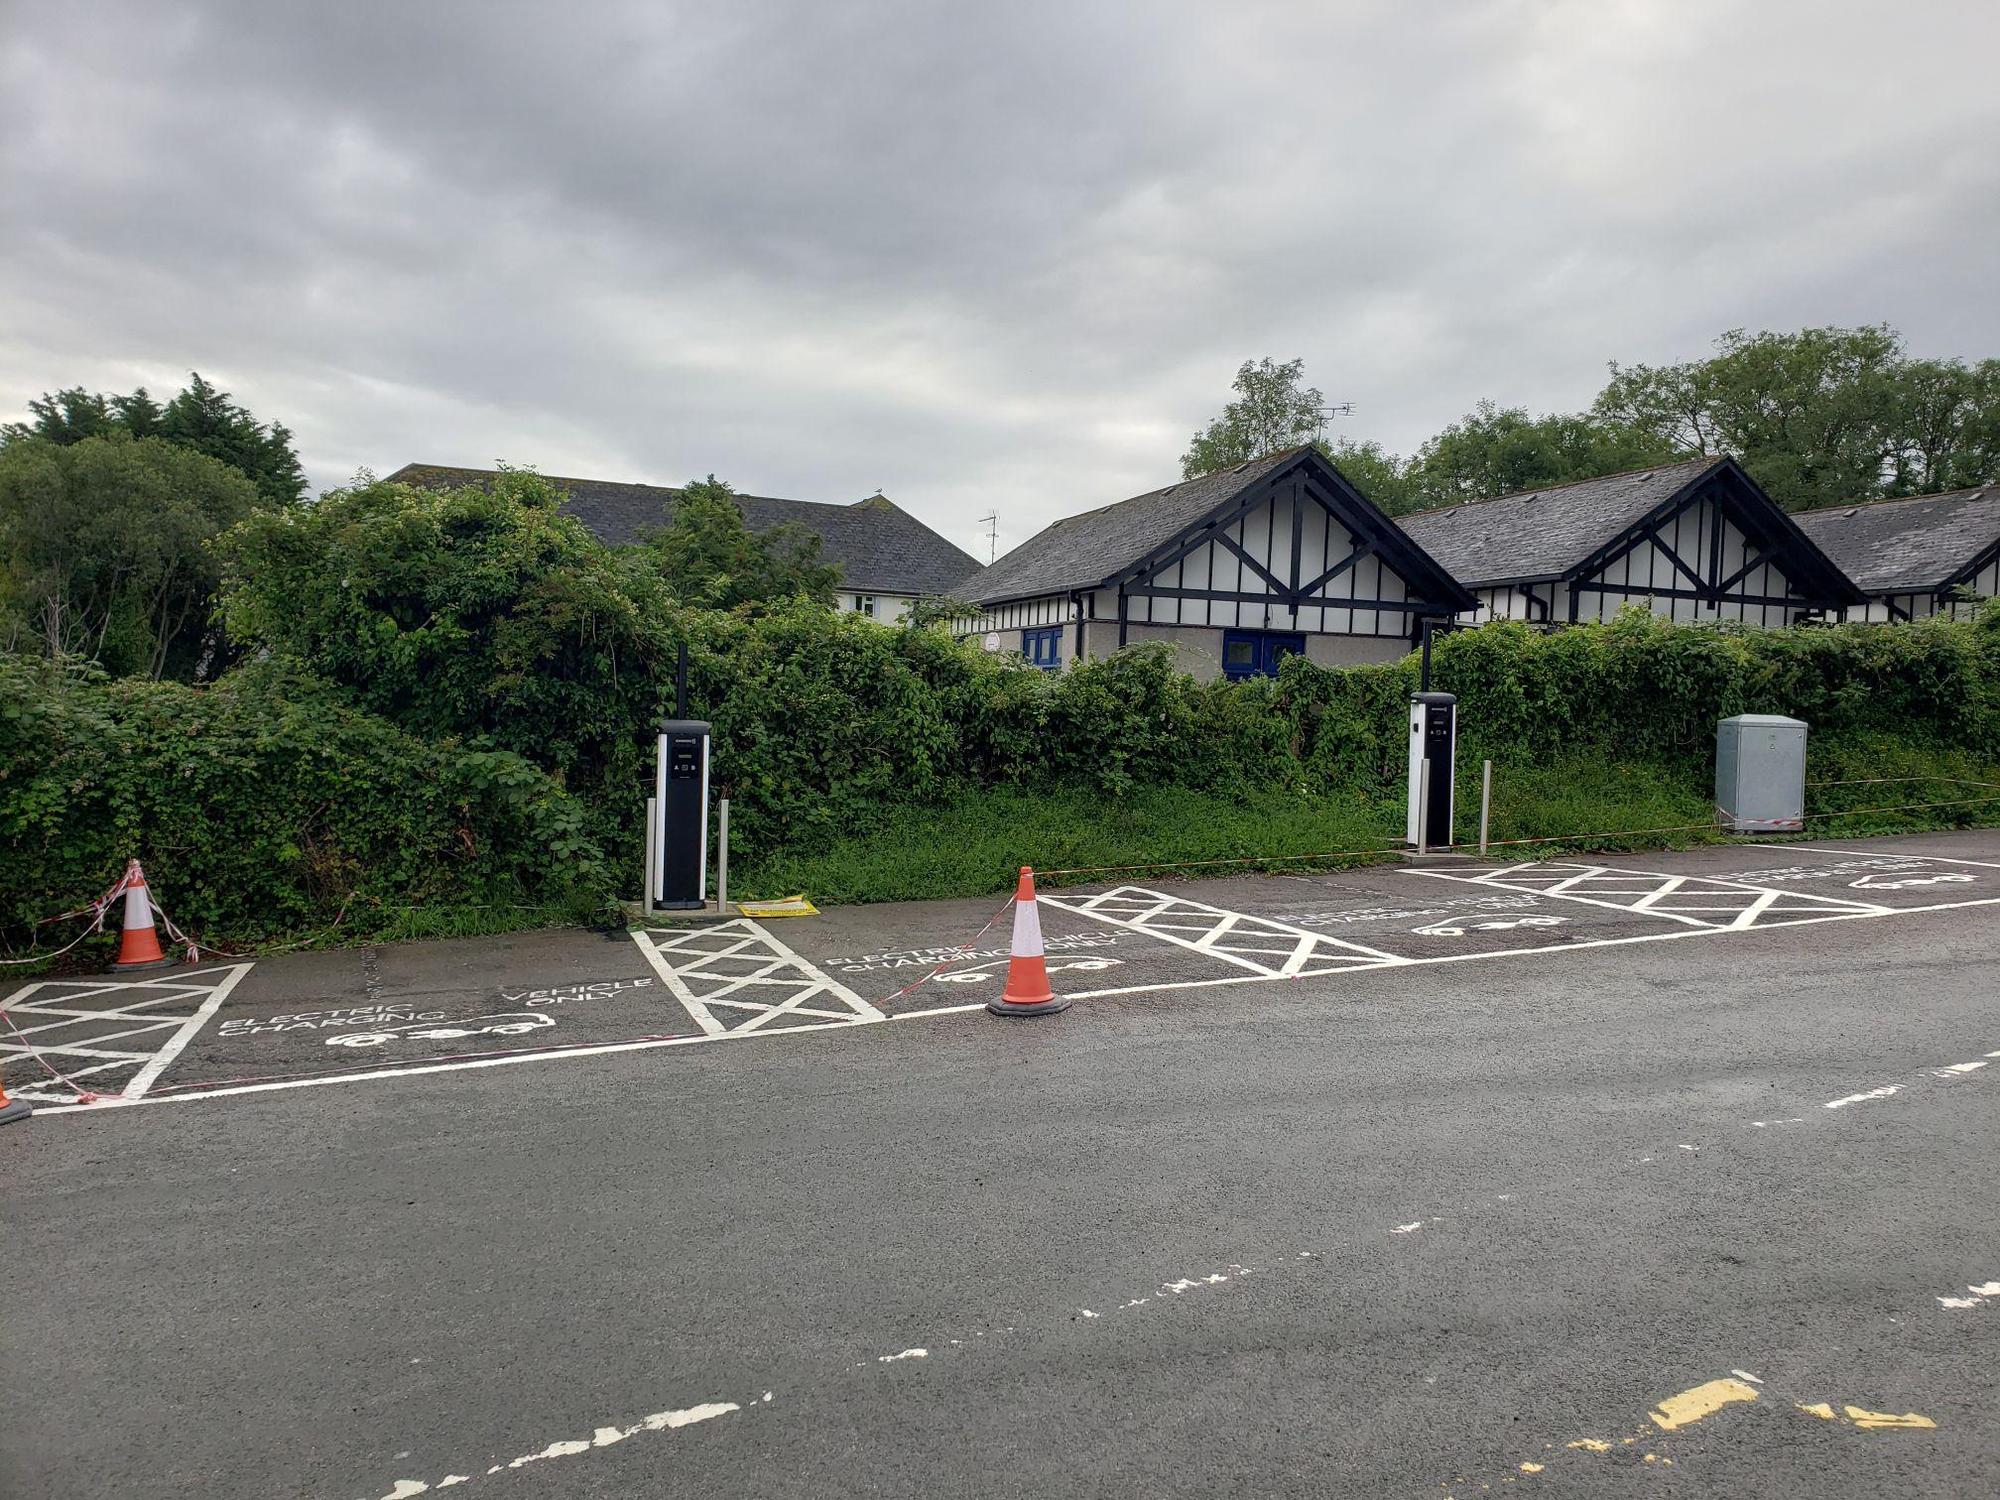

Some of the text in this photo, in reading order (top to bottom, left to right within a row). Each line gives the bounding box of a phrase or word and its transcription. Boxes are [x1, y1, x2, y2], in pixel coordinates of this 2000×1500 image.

[825, 944, 976, 965] ELECTRIC
[841, 938, 1118, 972] CHARGING ONLY
[218, 990, 623, 1036] CHARGING ONLY
[220, 978, 654, 1028] ELECTRIC VEHICLE
